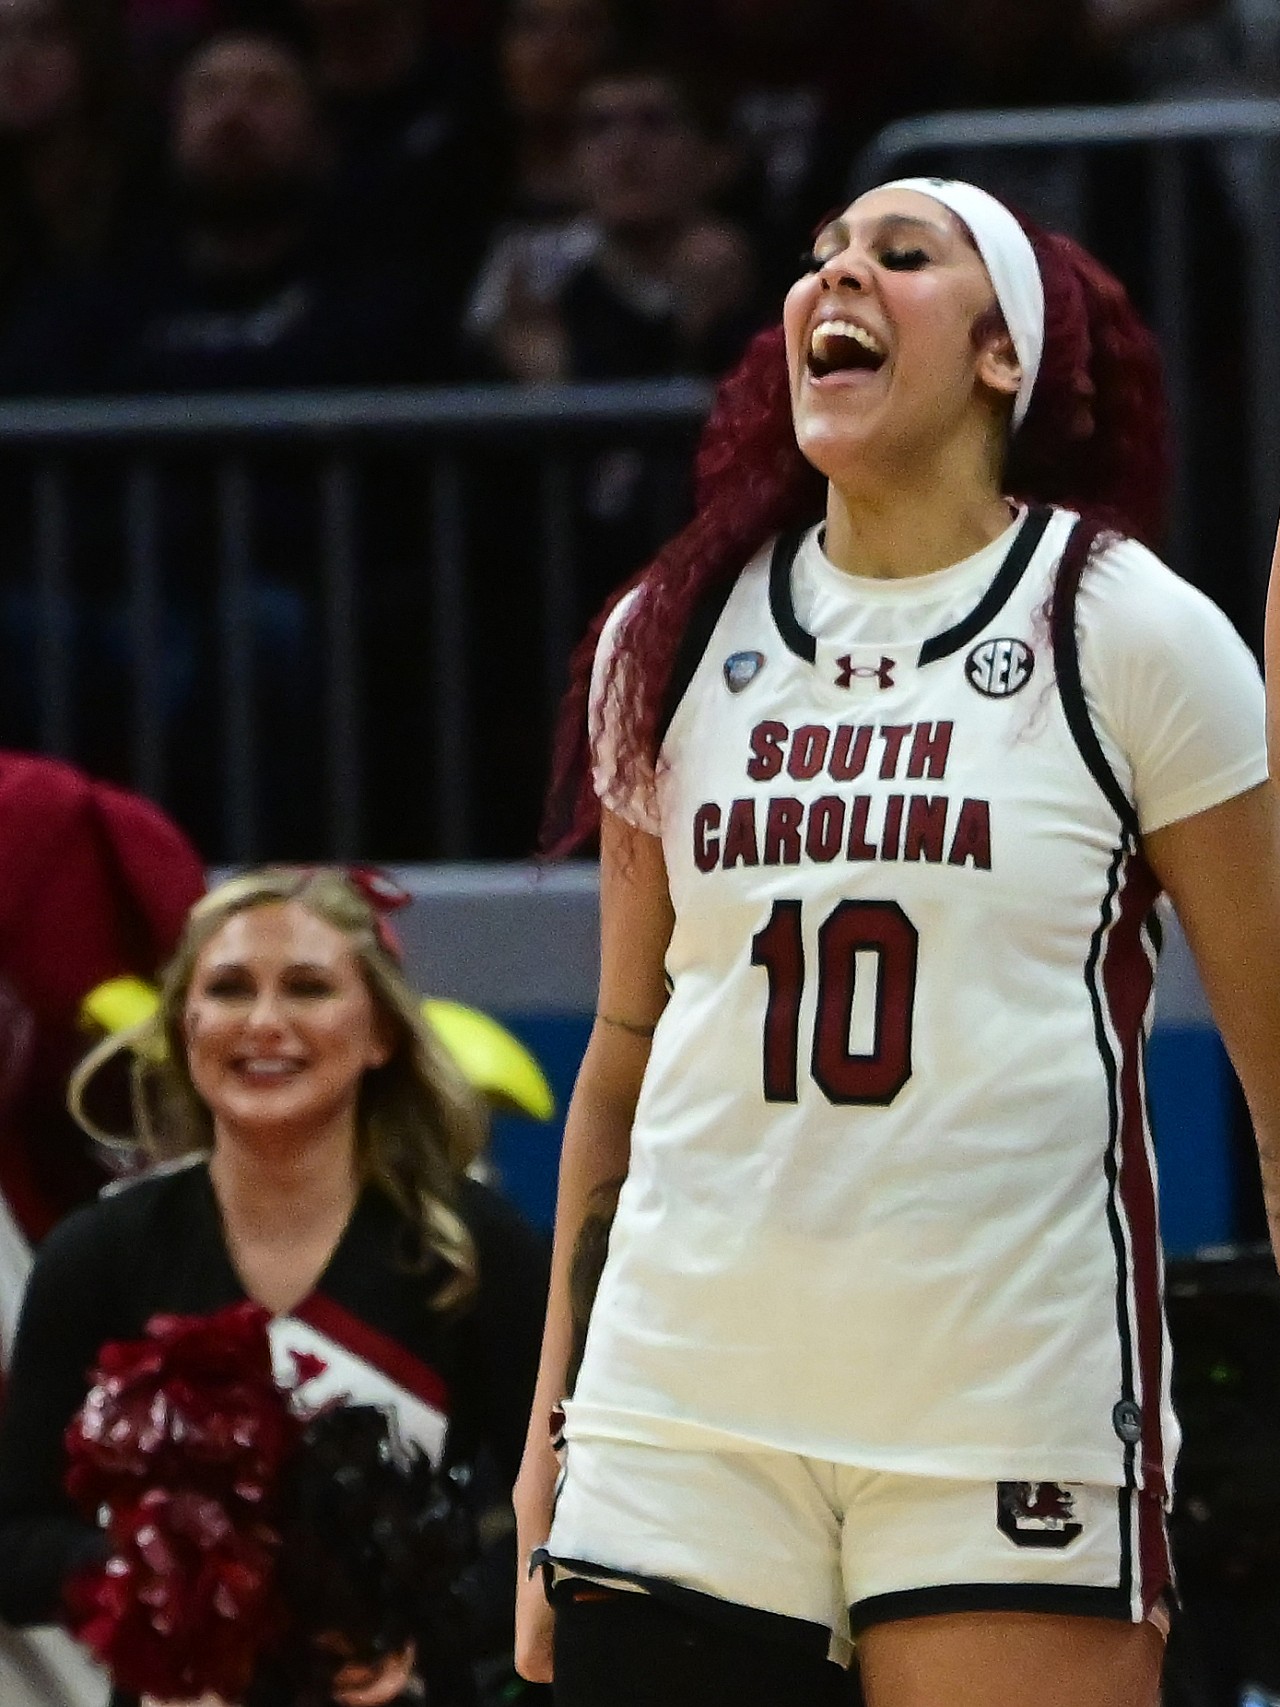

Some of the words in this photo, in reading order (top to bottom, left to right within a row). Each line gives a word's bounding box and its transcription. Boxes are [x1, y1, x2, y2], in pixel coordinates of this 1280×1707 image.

[970, 640, 1027, 694] SEC
[746, 719, 954, 782] SOUTH
[692, 794, 992, 873] CAROLINA
[750, 899, 920, 1106] 10
